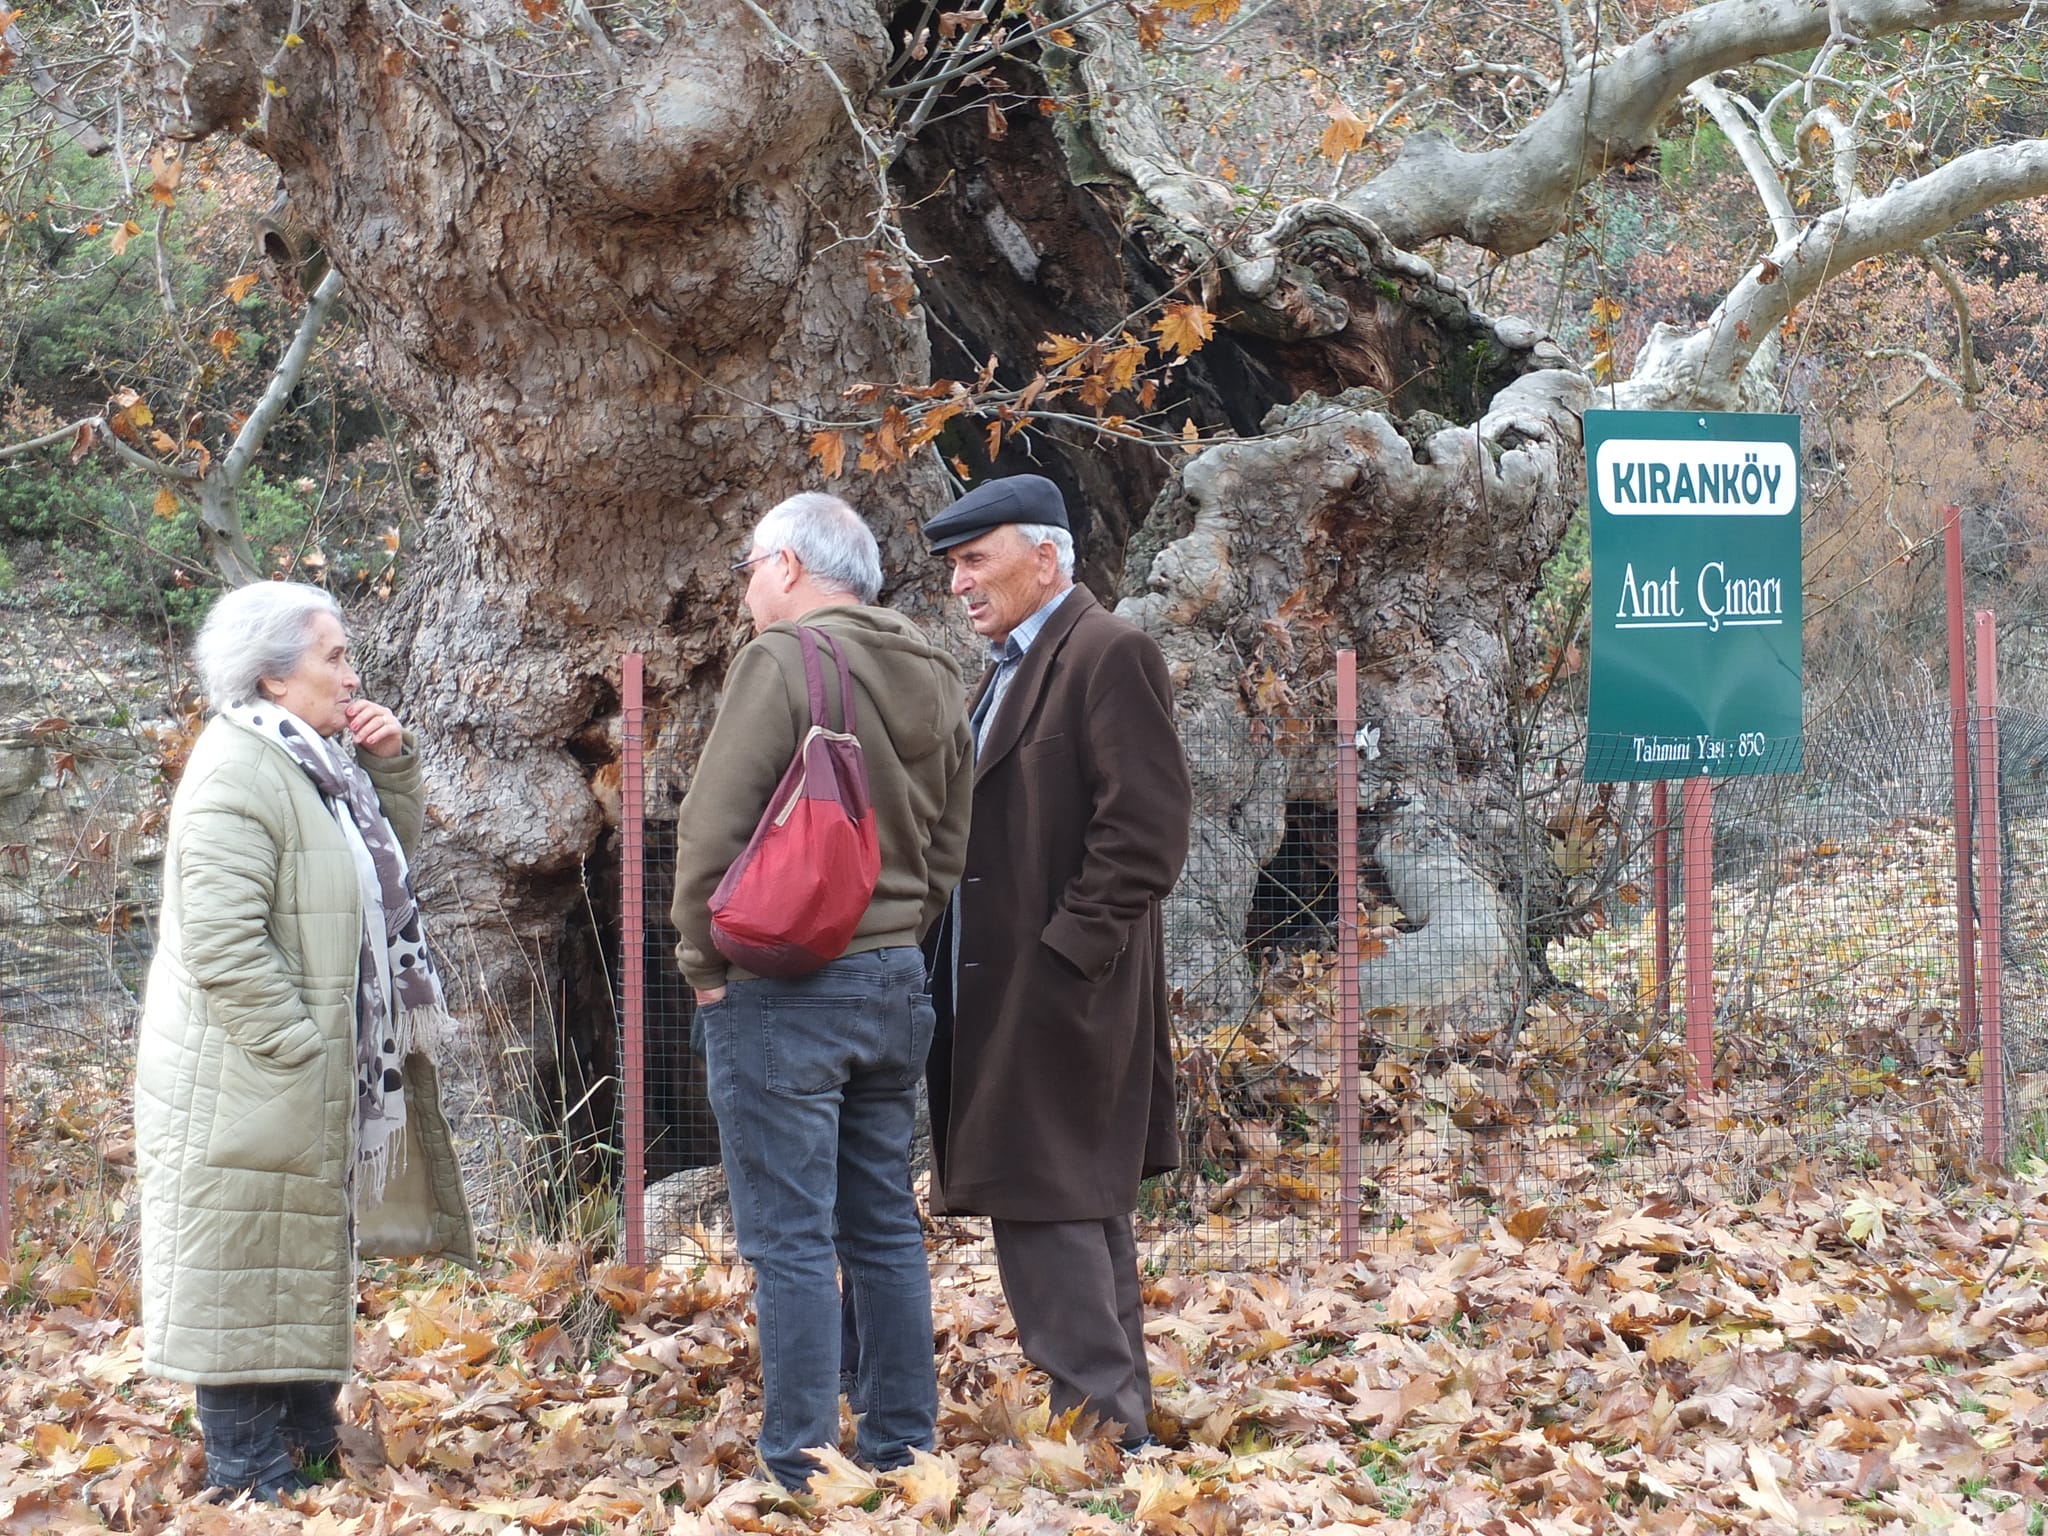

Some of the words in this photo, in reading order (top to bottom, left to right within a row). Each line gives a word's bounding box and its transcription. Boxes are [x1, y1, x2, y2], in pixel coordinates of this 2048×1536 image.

[1612, 452, 1782, 505] KIRANKÖY
[1616, 562, 1684, 619] Anıt
[1697, 561, 1783, 632] Çınarı
[1632, 735, 1690, 762] Tahmini
[1697, 735, 1725, 764] Yaşı
[1738, 731, 1766, 757] 850
